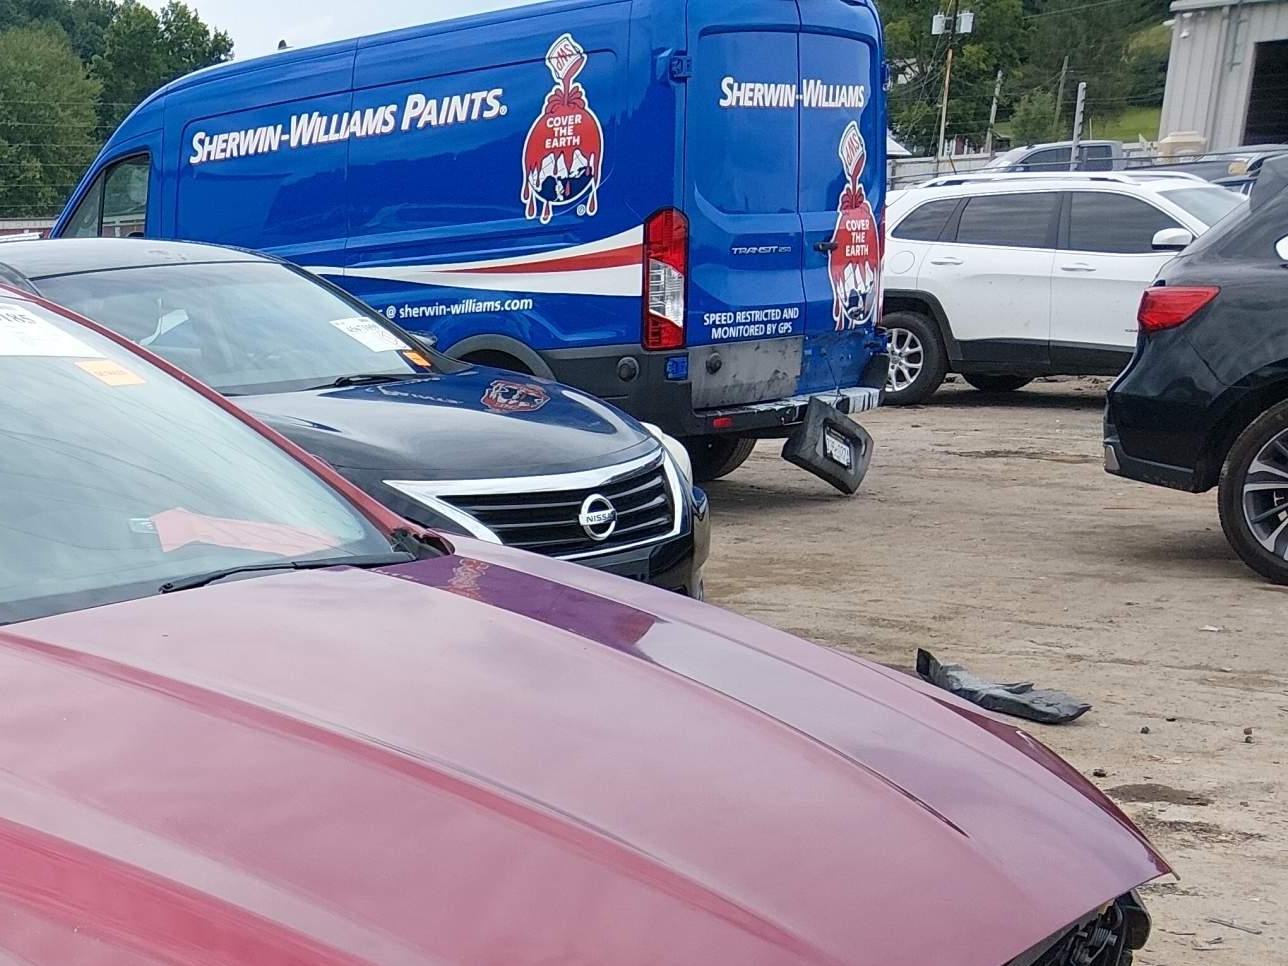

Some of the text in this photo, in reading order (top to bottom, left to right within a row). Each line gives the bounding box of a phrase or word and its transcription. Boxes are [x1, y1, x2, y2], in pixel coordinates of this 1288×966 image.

[720, 77, 864, 107] SHERWIN-WILLIAMS
[546, 114, 582, 128] COVER
[190, 104, 399, 163] SHERWIN-WILLIAMS
[553, 126, 574, 137] THE
[545, 136, 580, 149] EARTH
[846, 219, 869, 232] COVER
[851, 231, 866, 243] THE
[731, 245, 778, 255] TRANSIT
[846, 244, 869, 257] EARTH
[399, 298, 533, 319] sherwin-williams.com
[704, 307, 799, 325] SPEED RESTRICTED AND
[711, 321, 792, 340] MONITORED BY GPS
